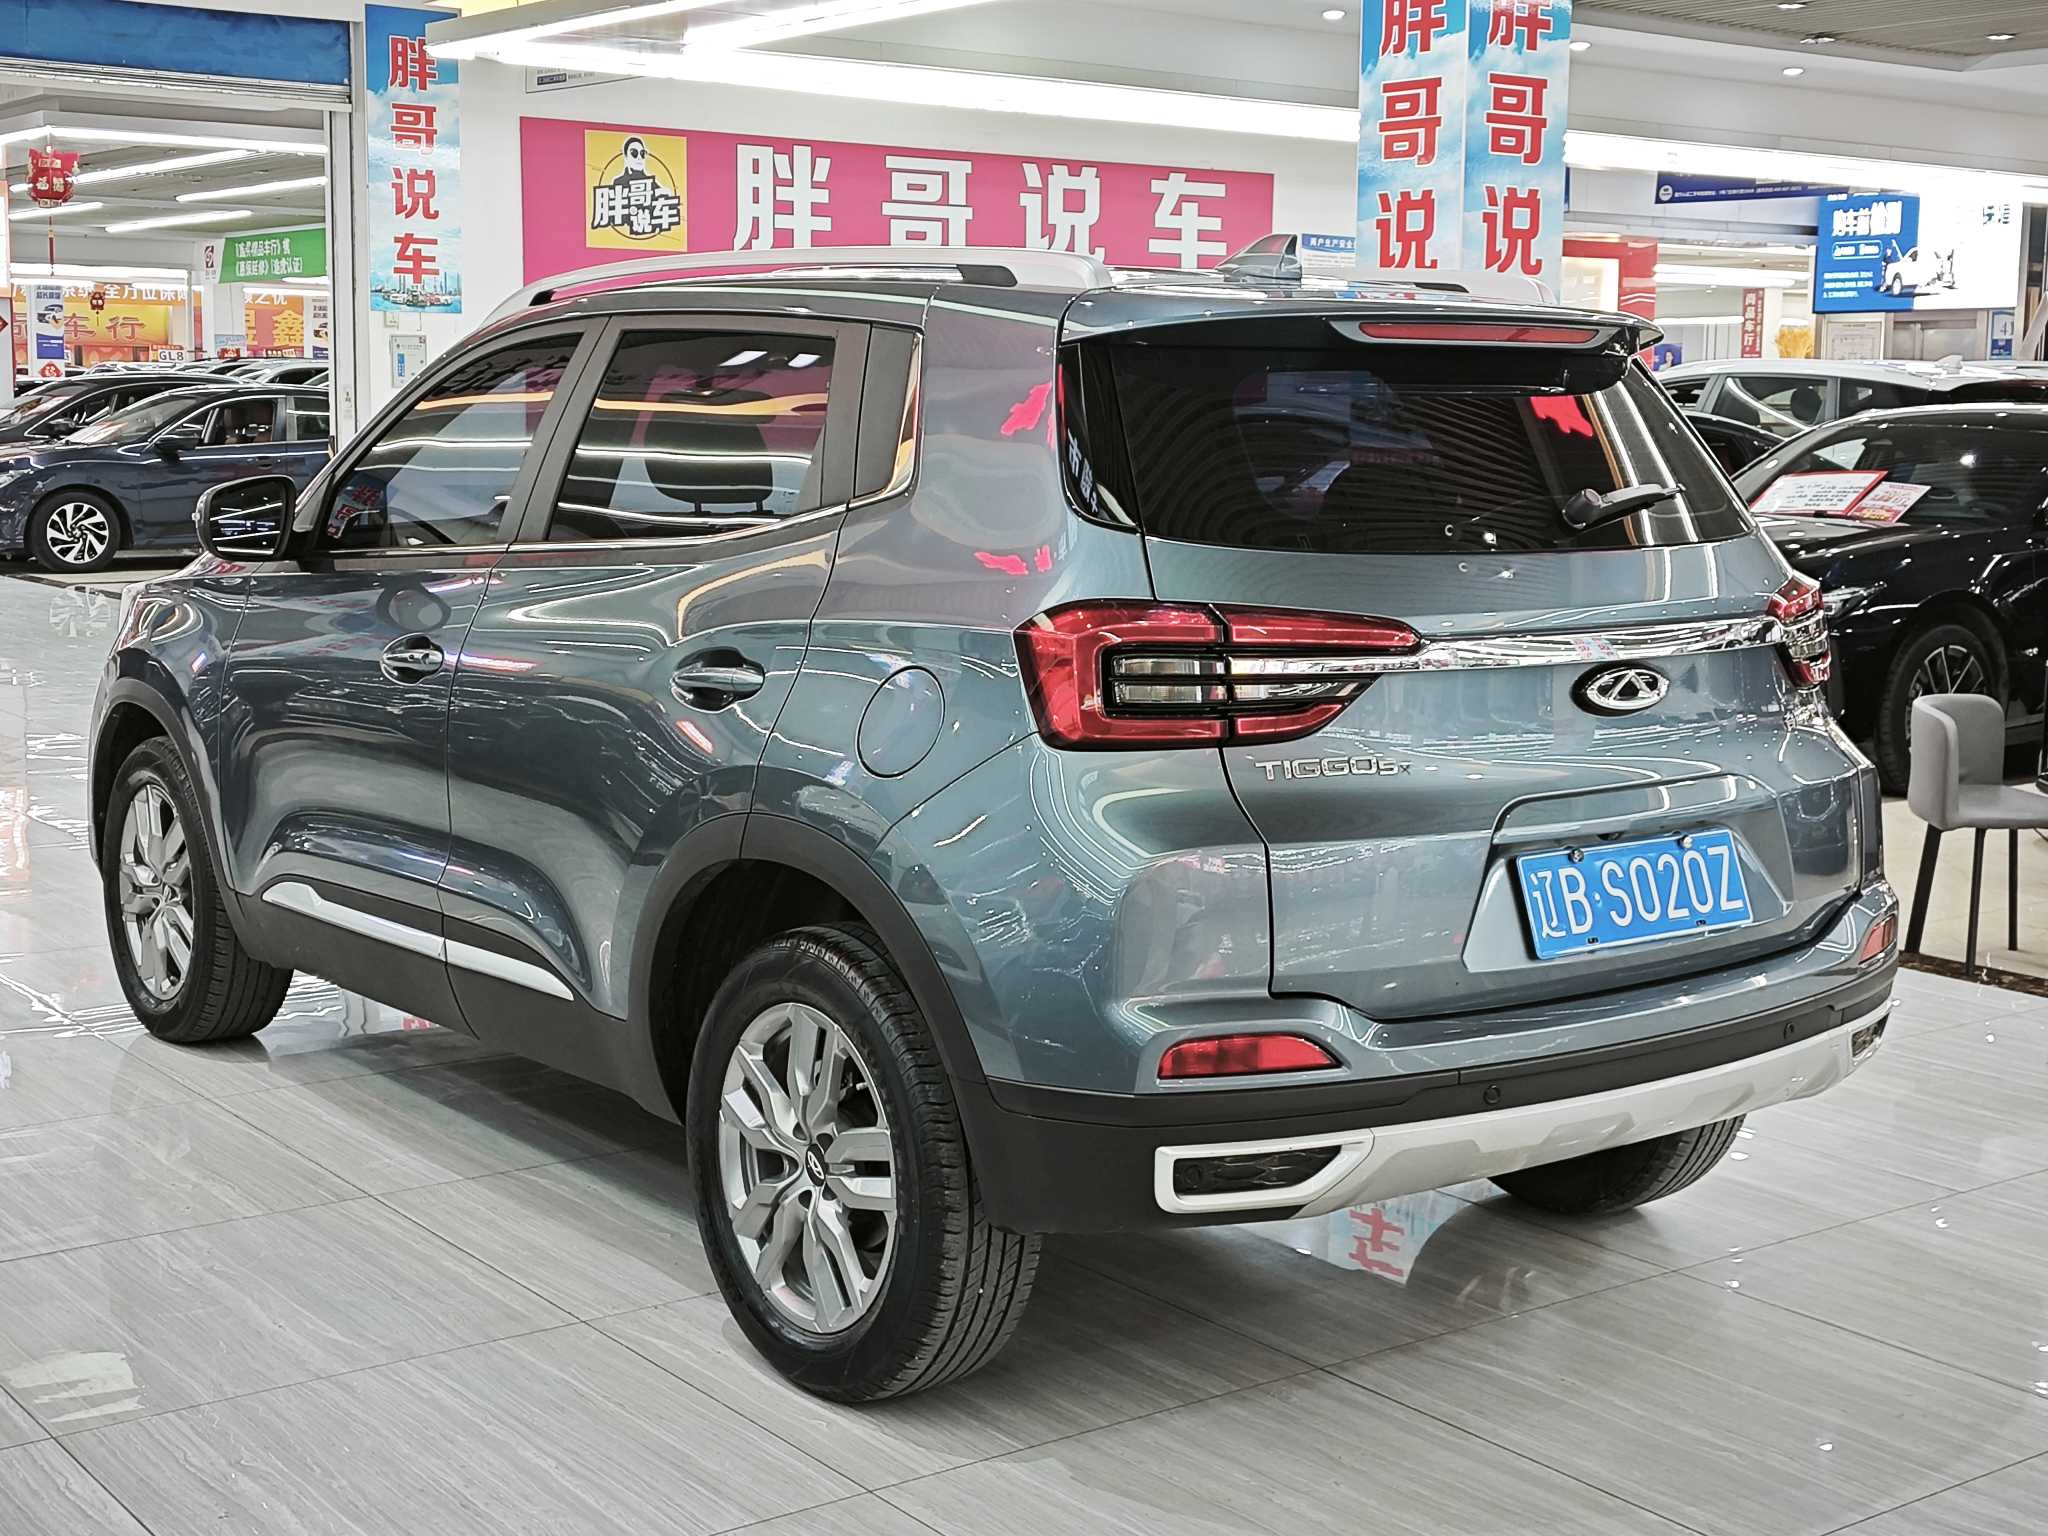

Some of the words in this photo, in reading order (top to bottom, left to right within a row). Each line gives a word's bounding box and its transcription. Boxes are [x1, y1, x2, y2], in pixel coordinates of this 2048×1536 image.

[389, 35, 441, 285] 胖哥说车
[733, 143, 1229, 270] 胖哥说车
[159, 350, 184, 361] GL8
